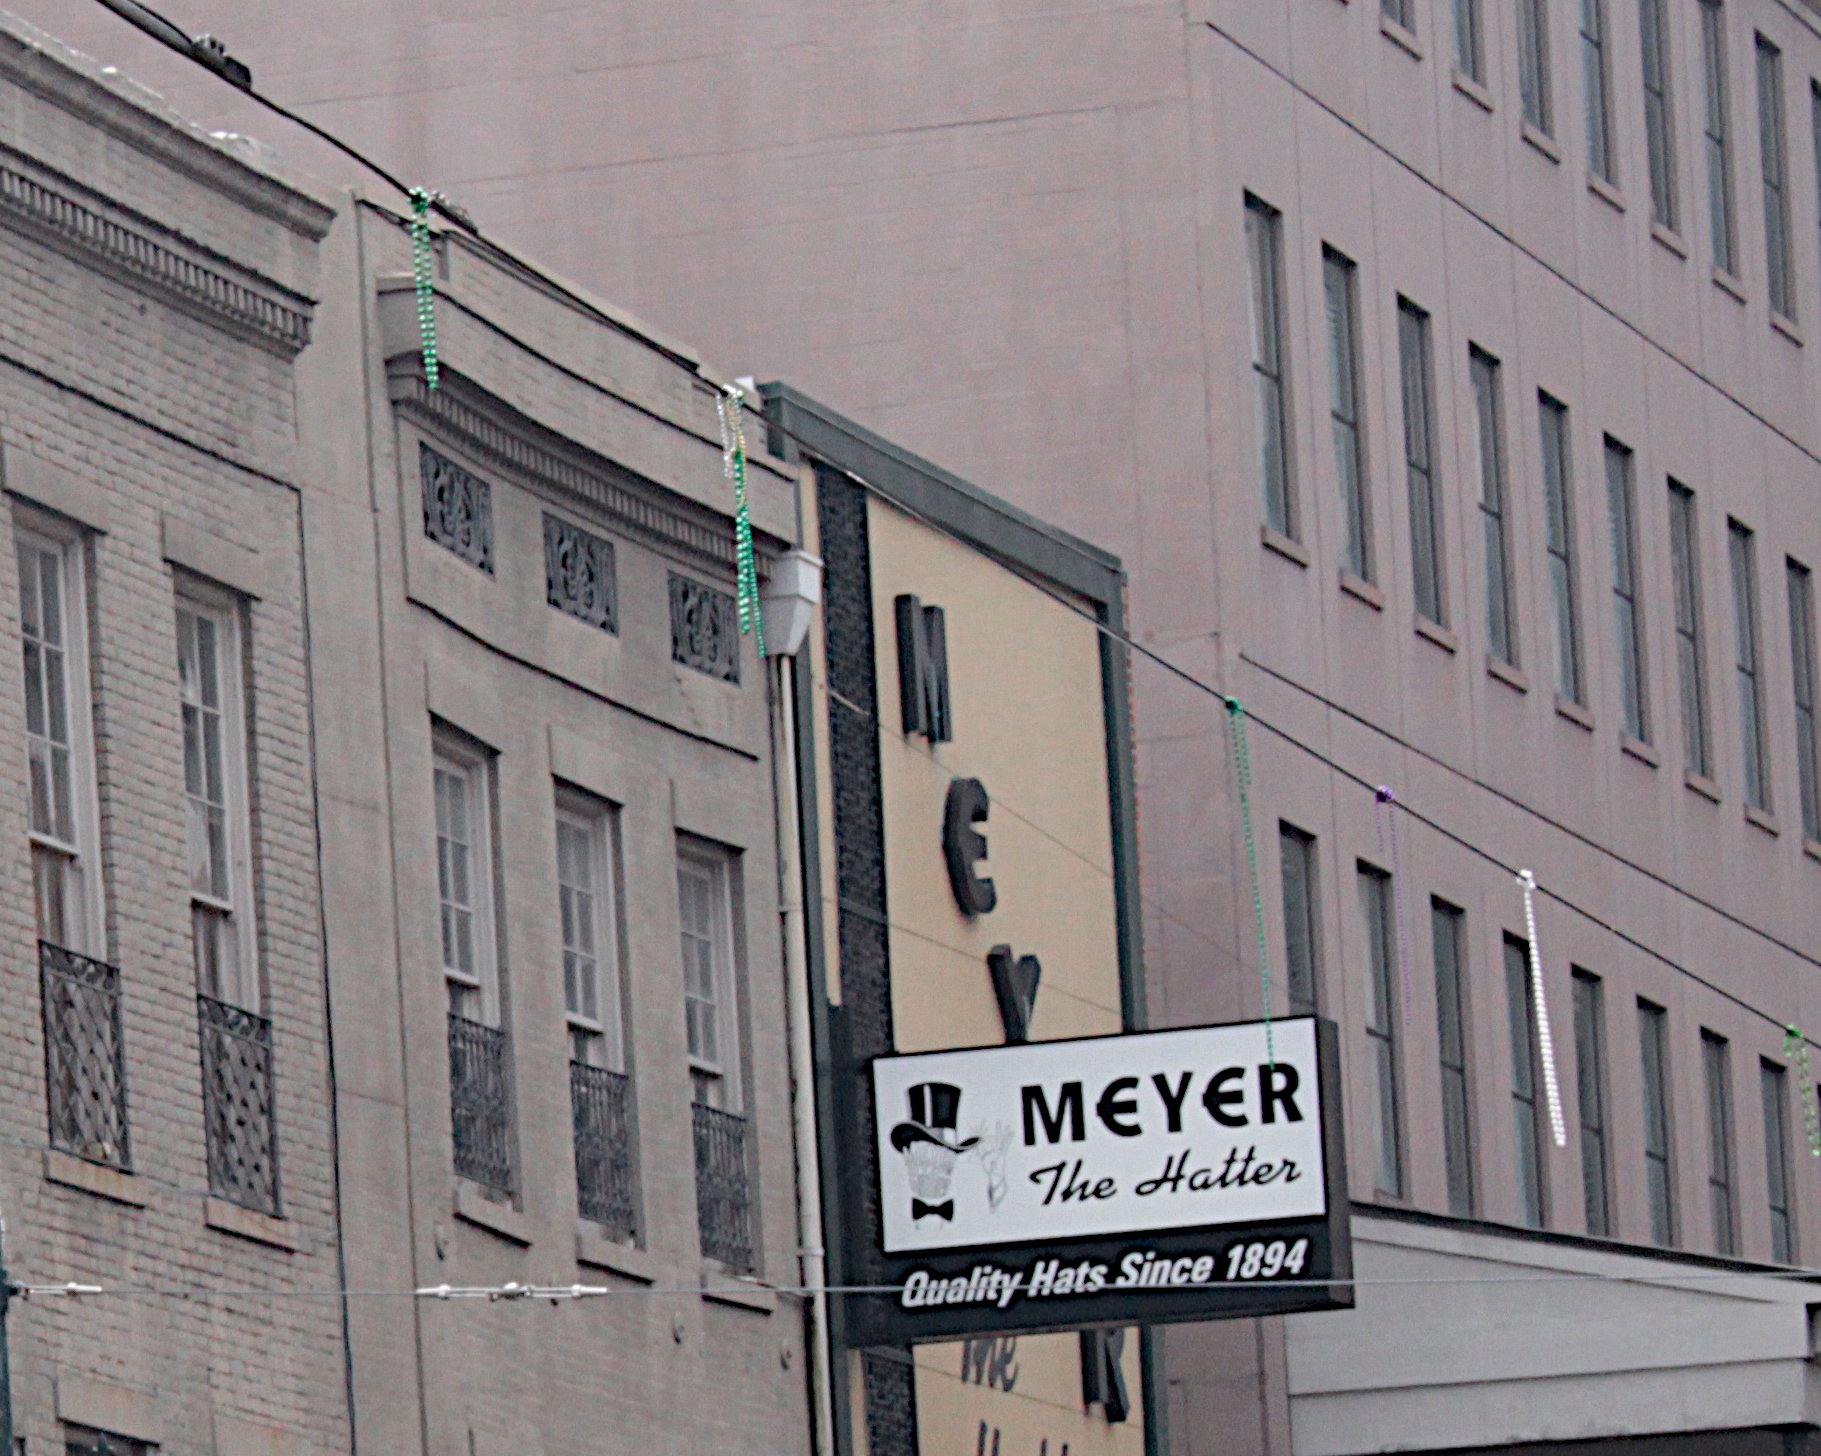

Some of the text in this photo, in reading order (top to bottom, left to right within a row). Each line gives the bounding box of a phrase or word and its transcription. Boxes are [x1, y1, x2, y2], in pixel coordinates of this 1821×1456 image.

[1021, 1062, 1303, 1147] MEYER
[1029, 1145, 1301, 1207] The Hatter
[901, 1239, 1309, 1309] Quality Hats Since 1894
